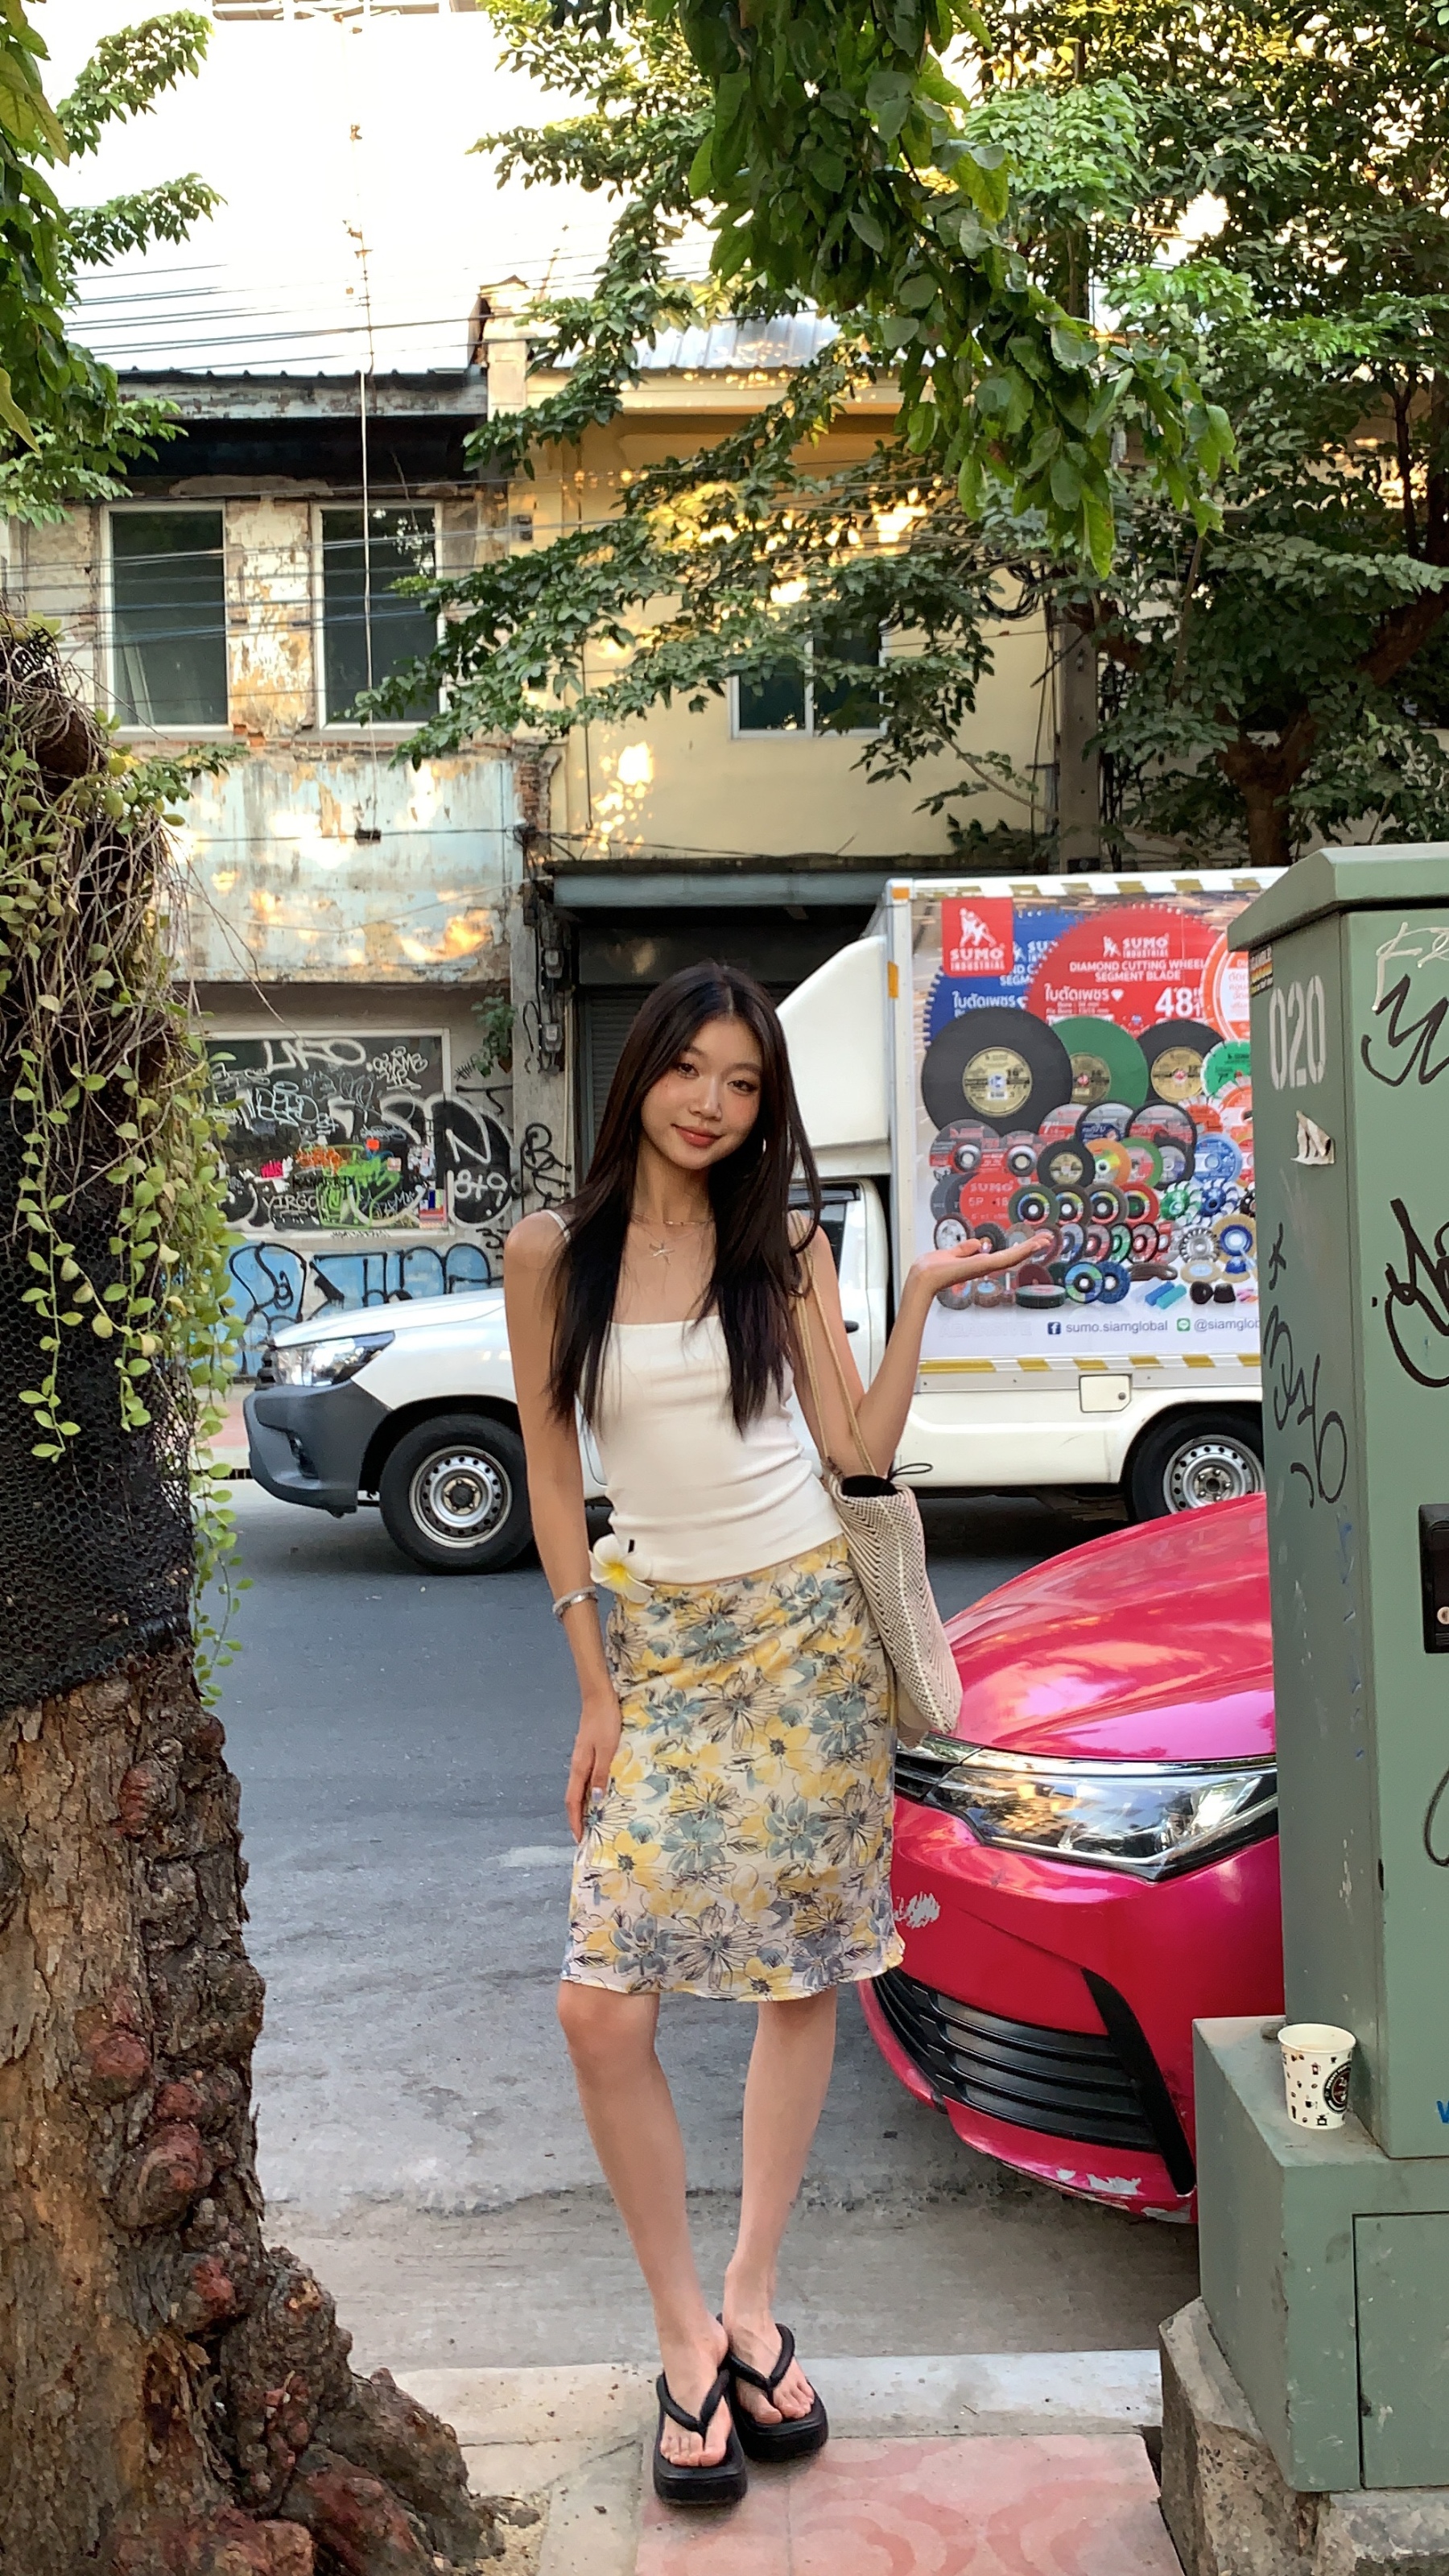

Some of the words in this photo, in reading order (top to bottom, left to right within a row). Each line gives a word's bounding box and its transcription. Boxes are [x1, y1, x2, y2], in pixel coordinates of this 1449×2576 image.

[1123, 937, 1166, 949] SUMO
[950, 947, 1004, 960] SUMO
[950, 960, 1005, 972] INDUSTRIAL
[1069, 960, 1120, 972] DIAMOND
[1122, 960, 1166, 972] CUTTING
[1095, 970, 1145, 983] SEGMENT
[1146, 969, 1181, 981] BLADE
[1269, 975, 1327, 1090] 020
[970, 1183, 1013, 1192] SUMO
[1066, 1320, 1168, 1333] sumo.siamglobal
